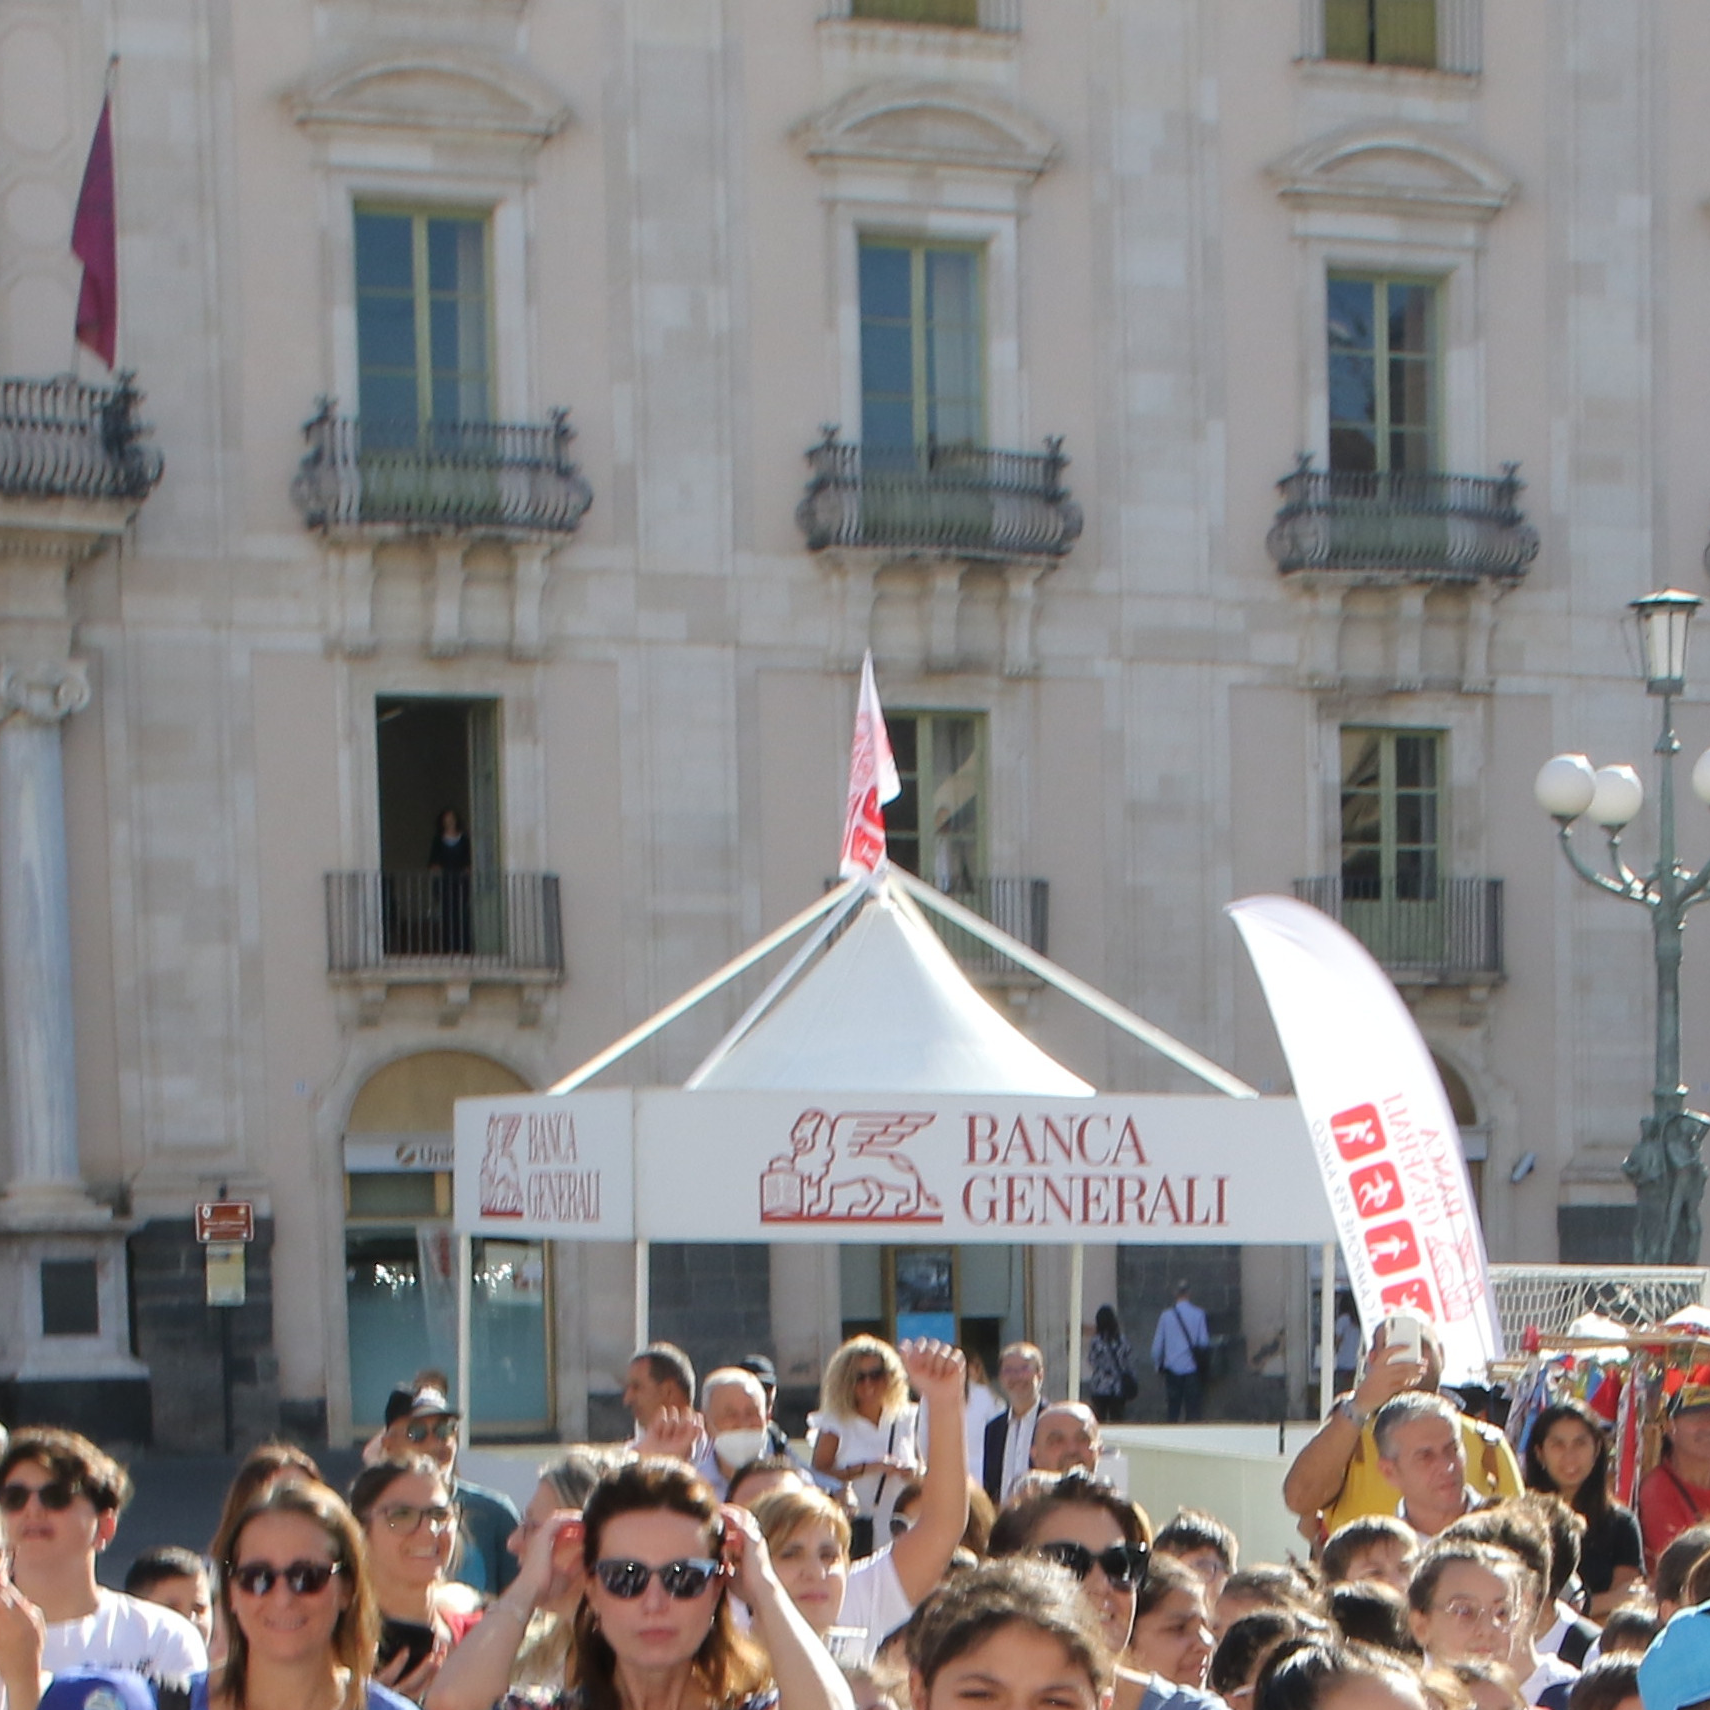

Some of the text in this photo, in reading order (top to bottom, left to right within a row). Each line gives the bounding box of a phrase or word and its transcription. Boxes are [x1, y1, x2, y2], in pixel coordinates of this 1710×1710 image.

[528, 1110, 578, 1165] BANCA
[961, 1112, 1151, 1167] BANCA
[527, 1168, 600, 1223] GENERALI
[962, 1173, 1231, 1228] GENERALI
